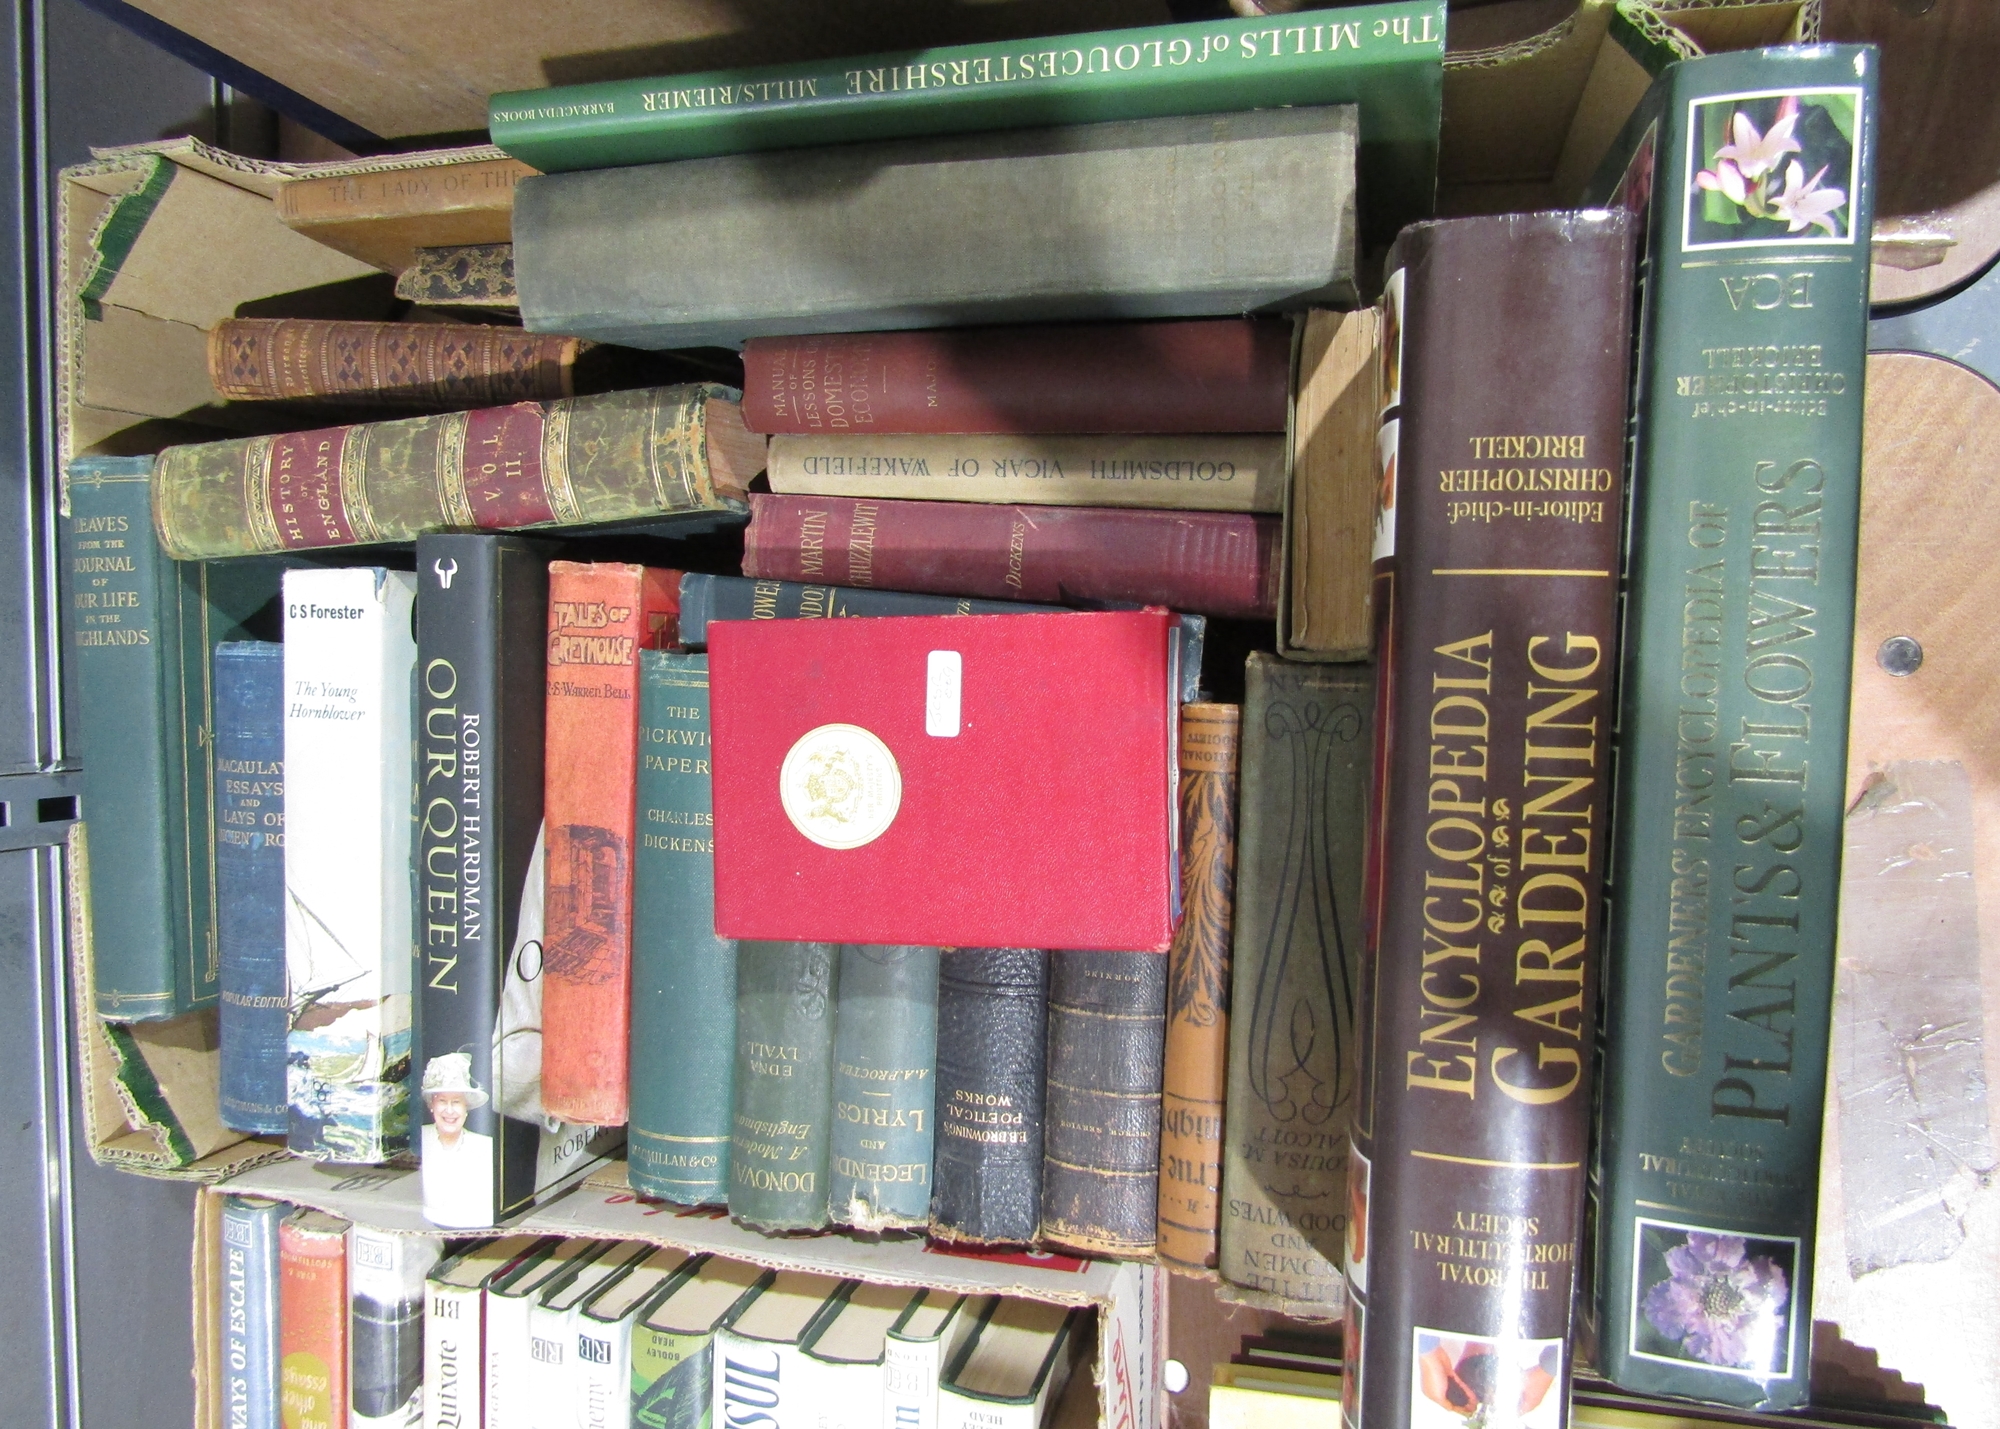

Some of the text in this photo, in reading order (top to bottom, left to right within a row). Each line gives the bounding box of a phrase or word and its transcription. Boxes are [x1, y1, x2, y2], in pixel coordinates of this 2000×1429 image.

[642, 15, 1440, 112] The MILLS of GLOUCESTERSHIRE MILLS/RIEMER
[493, 101, 614, 123] BARRACUDA BOOKS
[381, 180, 431, 198] LADY
[444, 173, 471, 192] OF
[1719, 273, 1815, 312] BCA
[1702, 344, 1823, 370] BRICKELL
[772, 348, 787, 417] MANUAL
[790, 374, 798, 390] OF
[802, 359, 822, 428] LESSONS
[1676, 371, 1846, 397] CHRISTOPHER
[1469, 435, 1586, 459] BRICKELL
[803, 455, 1236, 481] GOLDSMITH VICAR OF WAKEFIELD
[1439, 468, 1612, 492] CHRISTOPHER
[280, 445, 304, 541] HISTORY
[316, 440, 341, 540] ENGLAND
[1688, 500, 1728, 550] OF
[104, 540, 125, 548] THE
[801, 509, 828, 576] MARTIN
[847, 503, 879, 588] CHUZZLEWIT
[1005, 521, 1026, 590] DICKENS
[92, 578, 109, 587] OF
[103, 592, 141, 607] LIFE
[289, 604, 365, 620] C S Forester
[99, 614, 121, 623] THE
[553, 601, 631, 630] TALES OF
[1729, 457, 1827, 790] FLOWERS
[547, 629, 634, 667] GREYHOUSE
[295, 681, 358, 704] The Young
[1673, 557, 1728, 843] ENCYCLOPEDIA
[289, 703, 366, 722] Hornblower
[667, 705, 701, 720] THE
[226, 780, 285, 796] ESSAYS
[240, 799, 260, 807] AND
[224, 809, 256, 825] LAYS
[420, 658, 458, 996] OUR QUEEN
[463, 713, 481, 941] ROBERT HARDMAN
[1736, 798, 1805, 854] &
[1406, 629, 1493, 1101] ENCYCLOPEDIA
[1486, 853, 1511, 877] of
[1490, 630, 1601, 1105] GARDENING
[1711, 865, 1802, 1127] PLANTS
[747, 1041, 800, 1061] LYALL
[751, 1060, 793, 1077] EDNA
[955, 1089, 1013, 1107] WORKS
[837, 1101, 925, 1132] LYRICS
[946, 1103, 1024, 1125] POETICAL
[1060, 1121, 1103, 1134] SERVICE
[1254, 1127, 1344, 1148] ALCOTT
[788, 1145, 808, 1161] A
[860, 1139, 887, 1150] AND
[1242, 1142, 1265, 1163] M.
[1229, 1199, 1346, 1232] WIVES OOD
[1452, 1210, 1539, 1236] SOCIETY
[1271, 1232, 1319, 1251] AND
[229, 1249, 247, 1334] ESCAPE
[1246, 1272, 1344, 1304] LITTLE
[579, 1333, 611, 1364] RB
[652, 1334, 675, 1348] HEAD
[231, 1339, 247, 1371] OF
[646, 1349, 680, 1362] BODLEY
[969, 1411, 1004, 1426] HEAD
